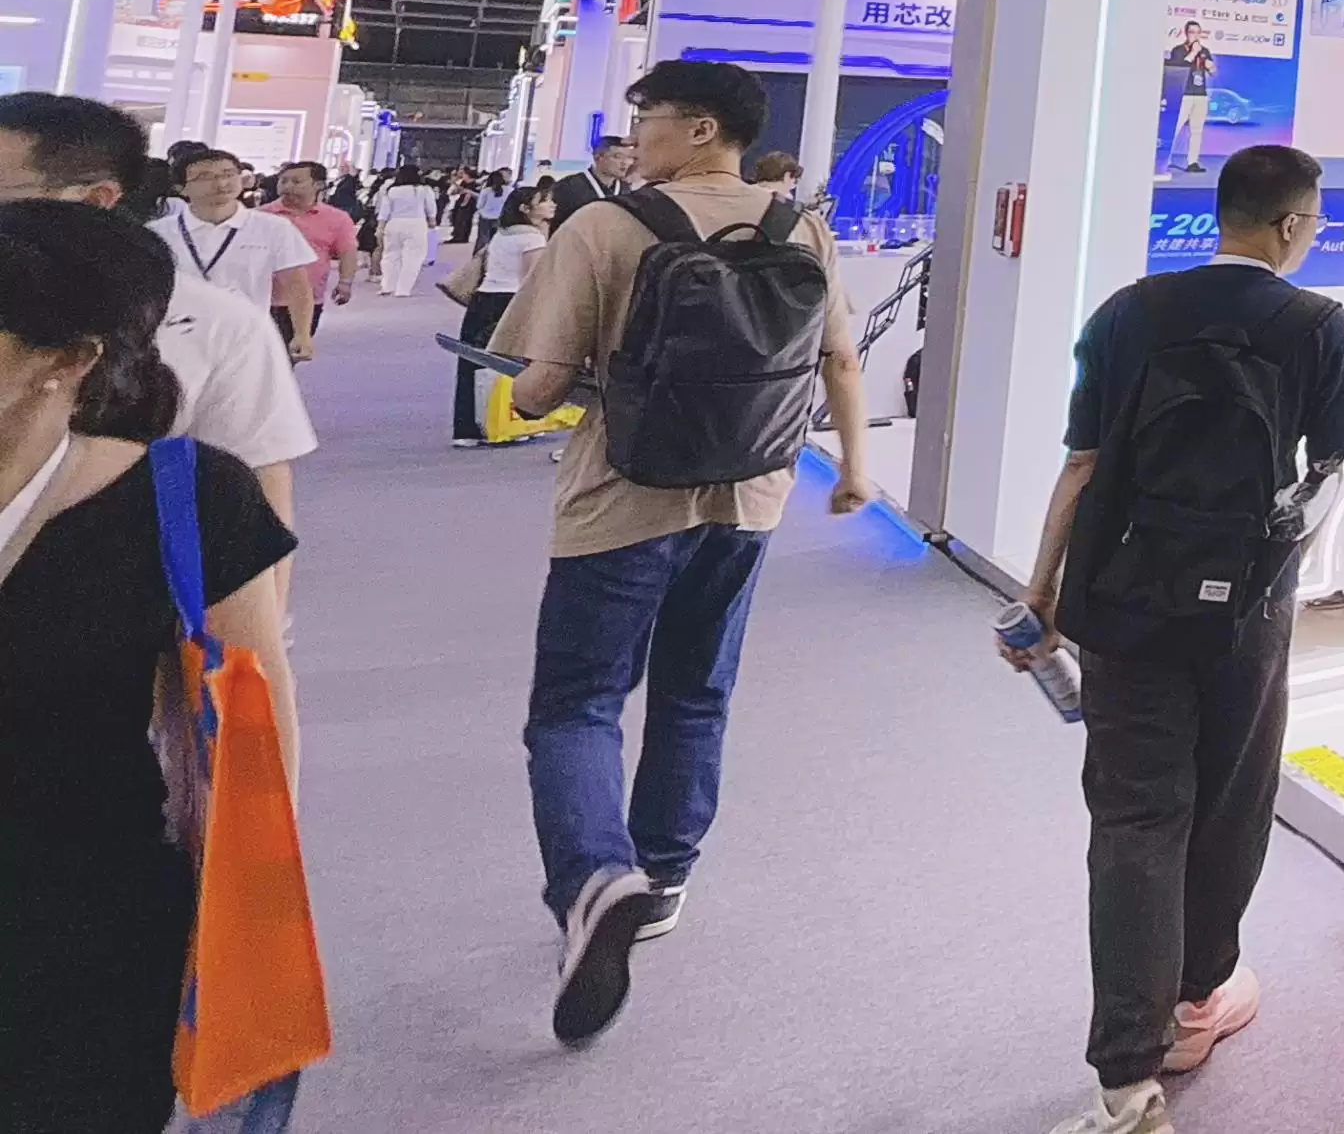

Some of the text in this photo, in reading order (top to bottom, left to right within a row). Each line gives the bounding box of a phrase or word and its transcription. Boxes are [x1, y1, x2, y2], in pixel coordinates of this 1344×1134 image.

[861, 0, 953, 28] 用芯改
[1151, 237, 1219, 252] 共建共享
